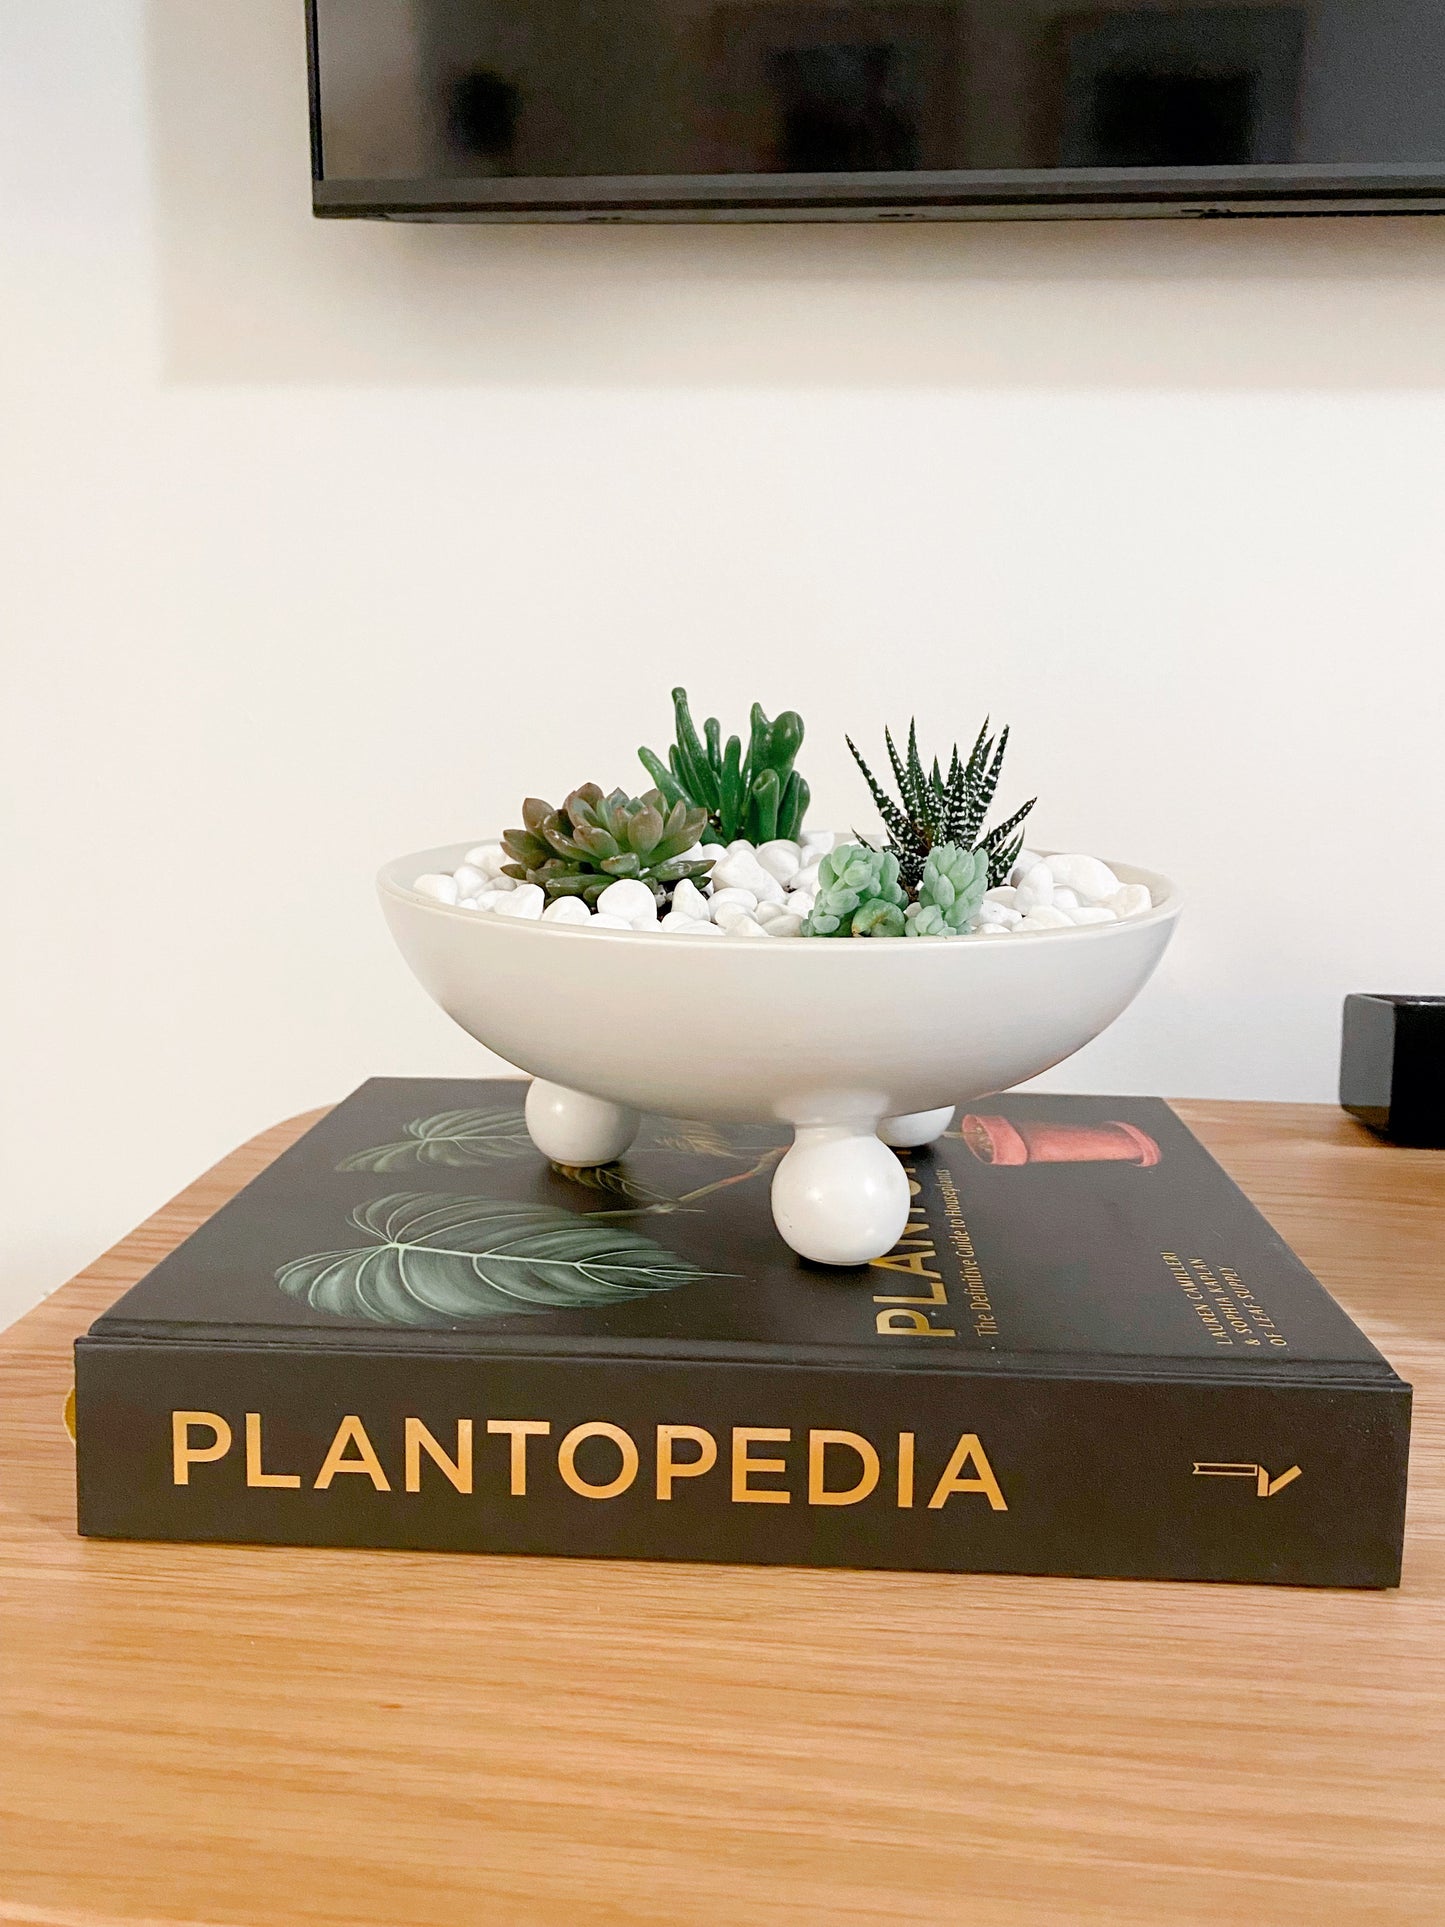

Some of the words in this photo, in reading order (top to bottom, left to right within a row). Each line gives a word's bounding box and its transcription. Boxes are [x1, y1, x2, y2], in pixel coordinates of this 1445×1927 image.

[934, 1169, 961, 1216] Houseplants
[950, 1218, 966, 1228] to
[949, 1229, 975, 1257] Guide
[962, 1259, 991, 1311] Definitive
[1160, 1251, 1203, 1300] CAMILLERI
[1188, 1258, 1225, 1293] KAPLAN
[1216, 1265, 1255, 1300] SUPPLY
[974, 1314, 999, 1336] The
[1193, 1303, 1233, 1345] LAUREN
[1215, 1296, 1253, 1334] SOPHIA
[1243, 1302, 1275, 1328] LEAF
[1244, 1338, 1261, 1346] &
[1264, 1332, 1287, 1346] OF
[172, 1410, 1008, 1511] PLANTOPEDIA
